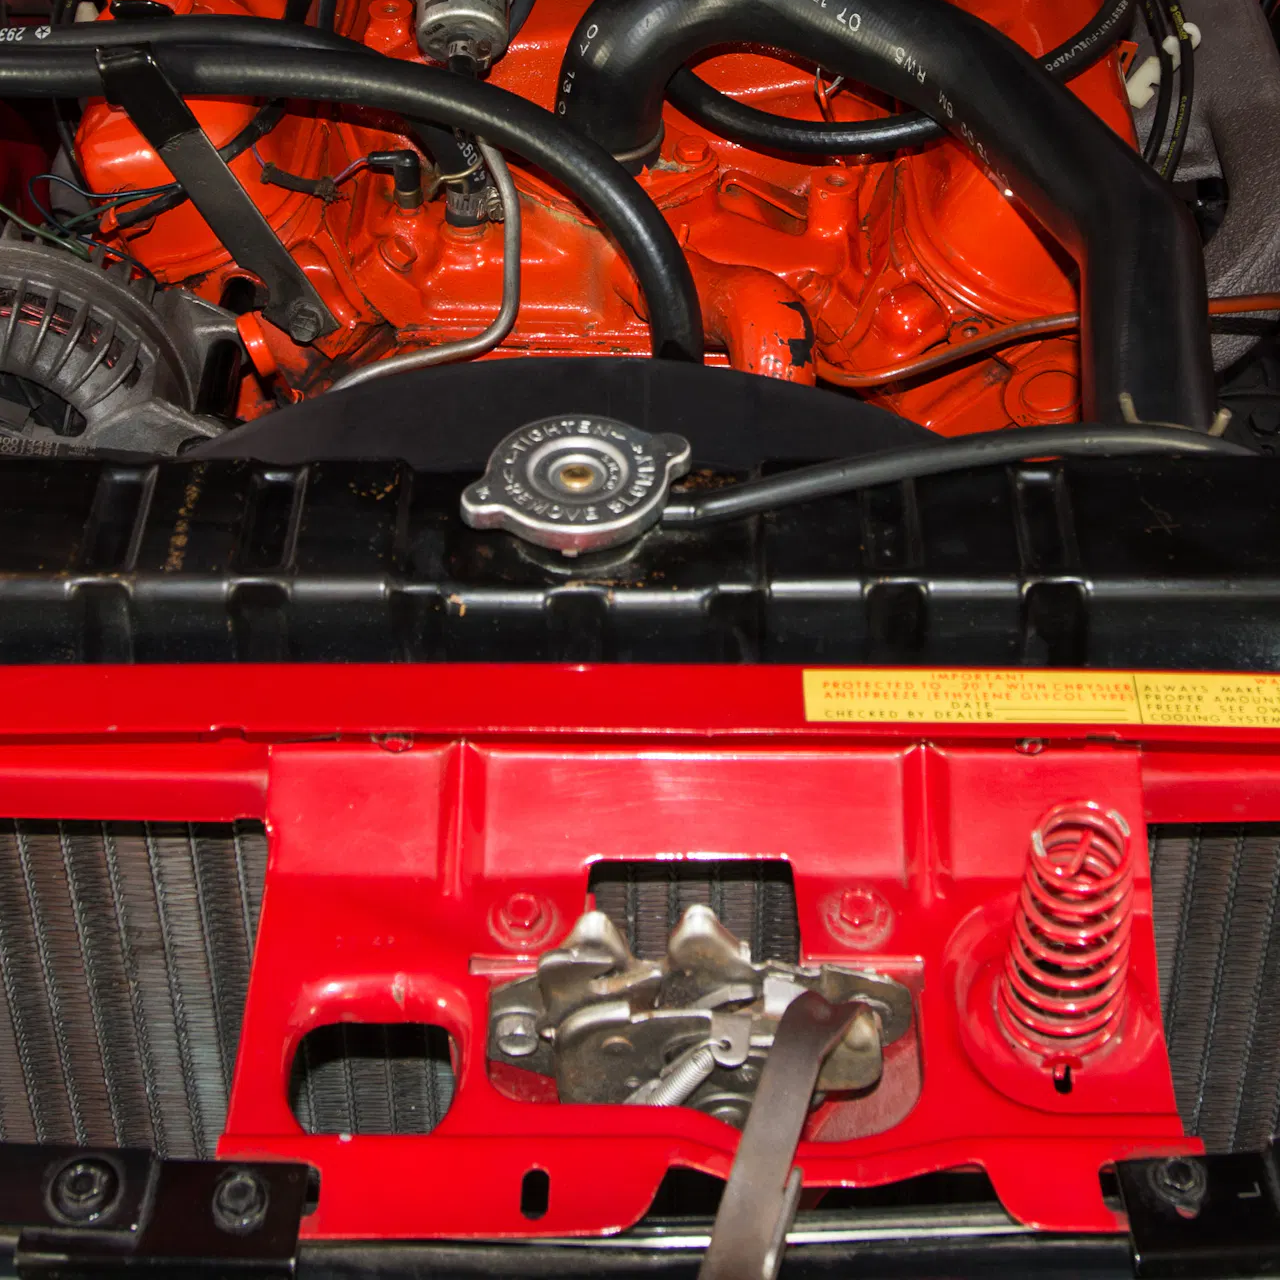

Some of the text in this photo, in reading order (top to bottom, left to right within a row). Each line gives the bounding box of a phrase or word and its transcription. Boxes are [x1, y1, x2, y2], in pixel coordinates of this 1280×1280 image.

[836, 10, 862, 33] 07
[511, 420, 612, 452] TIGHTEN
[505, 482, 600, 522] REMOVE
[931, 671, 1026, 682] IMPORTANT
[822, 680, 915, 691] PROTECTED
[921, 681, 942, 691] TO
[1006, 681, 1047, 692] WITH
[1052, 682, 1134, 692] CHRYSLER
[1143, 684, 1209, 694] ALWAYS
[1221, 685, 1266, 695] MAKE
[823, 691, 920, 701] ANTIFREEZE
[1019, 692, 1084, 702] GLYCOL
[1144, 693, 1205, 704] PROPER
[951, 700, 992, 710] DATE
[1219, 705, 1247, 714] SEE
[824, 710, 994, 720] CHECKED BY DEALER
[1150, 713, 1222, 724] COOLING
